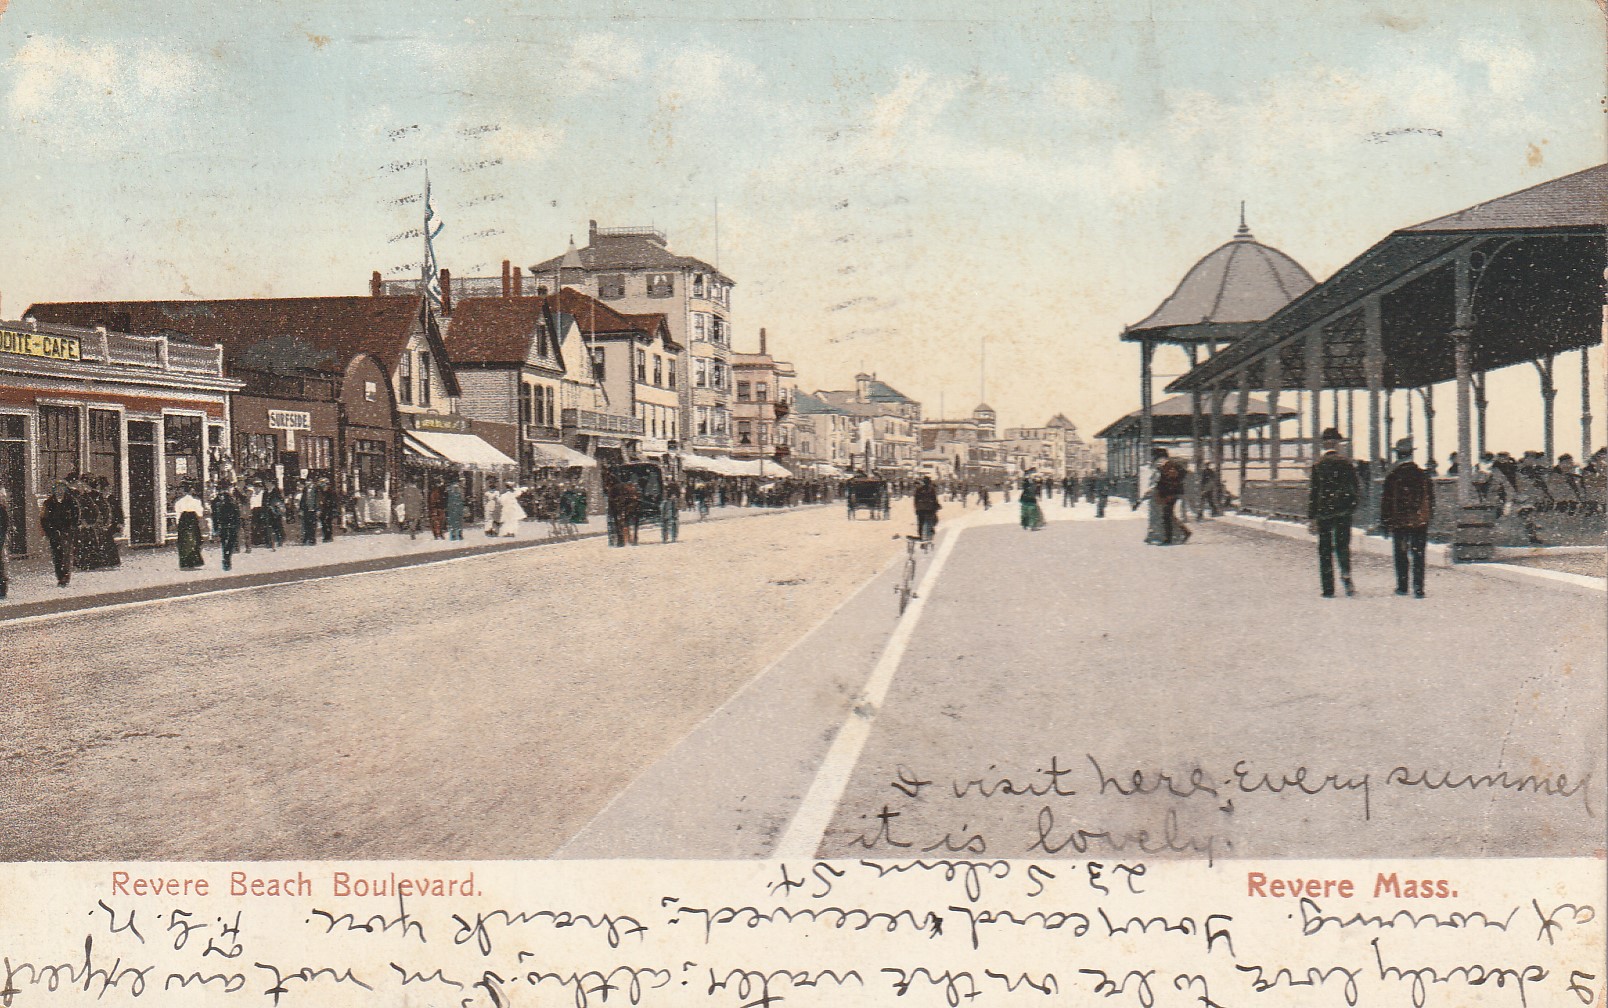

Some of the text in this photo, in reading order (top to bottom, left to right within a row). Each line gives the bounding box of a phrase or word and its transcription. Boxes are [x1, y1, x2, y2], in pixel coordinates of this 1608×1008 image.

[271, 412, 308, 428] SURFSIDE
[953, 756, 1076, 797] visit
[1387, 766, 1596, 818] summer
[848, 805, 913, 848] it
[921, 824, 986, 852] is
[452, 910, 649, 956] thank
[1532, 898, 1596, 946] at
[254, 962, 374, 1008] not
[880, 968, 983, 1008] the
[984, 969, 1059, 996] on
[1078, 969, 1156, 1008] be
[1174, 974, 1225, 1008] to
[1236, 964, 1362, 1007] love
[1370, 936, 1550, 1008] dearly
